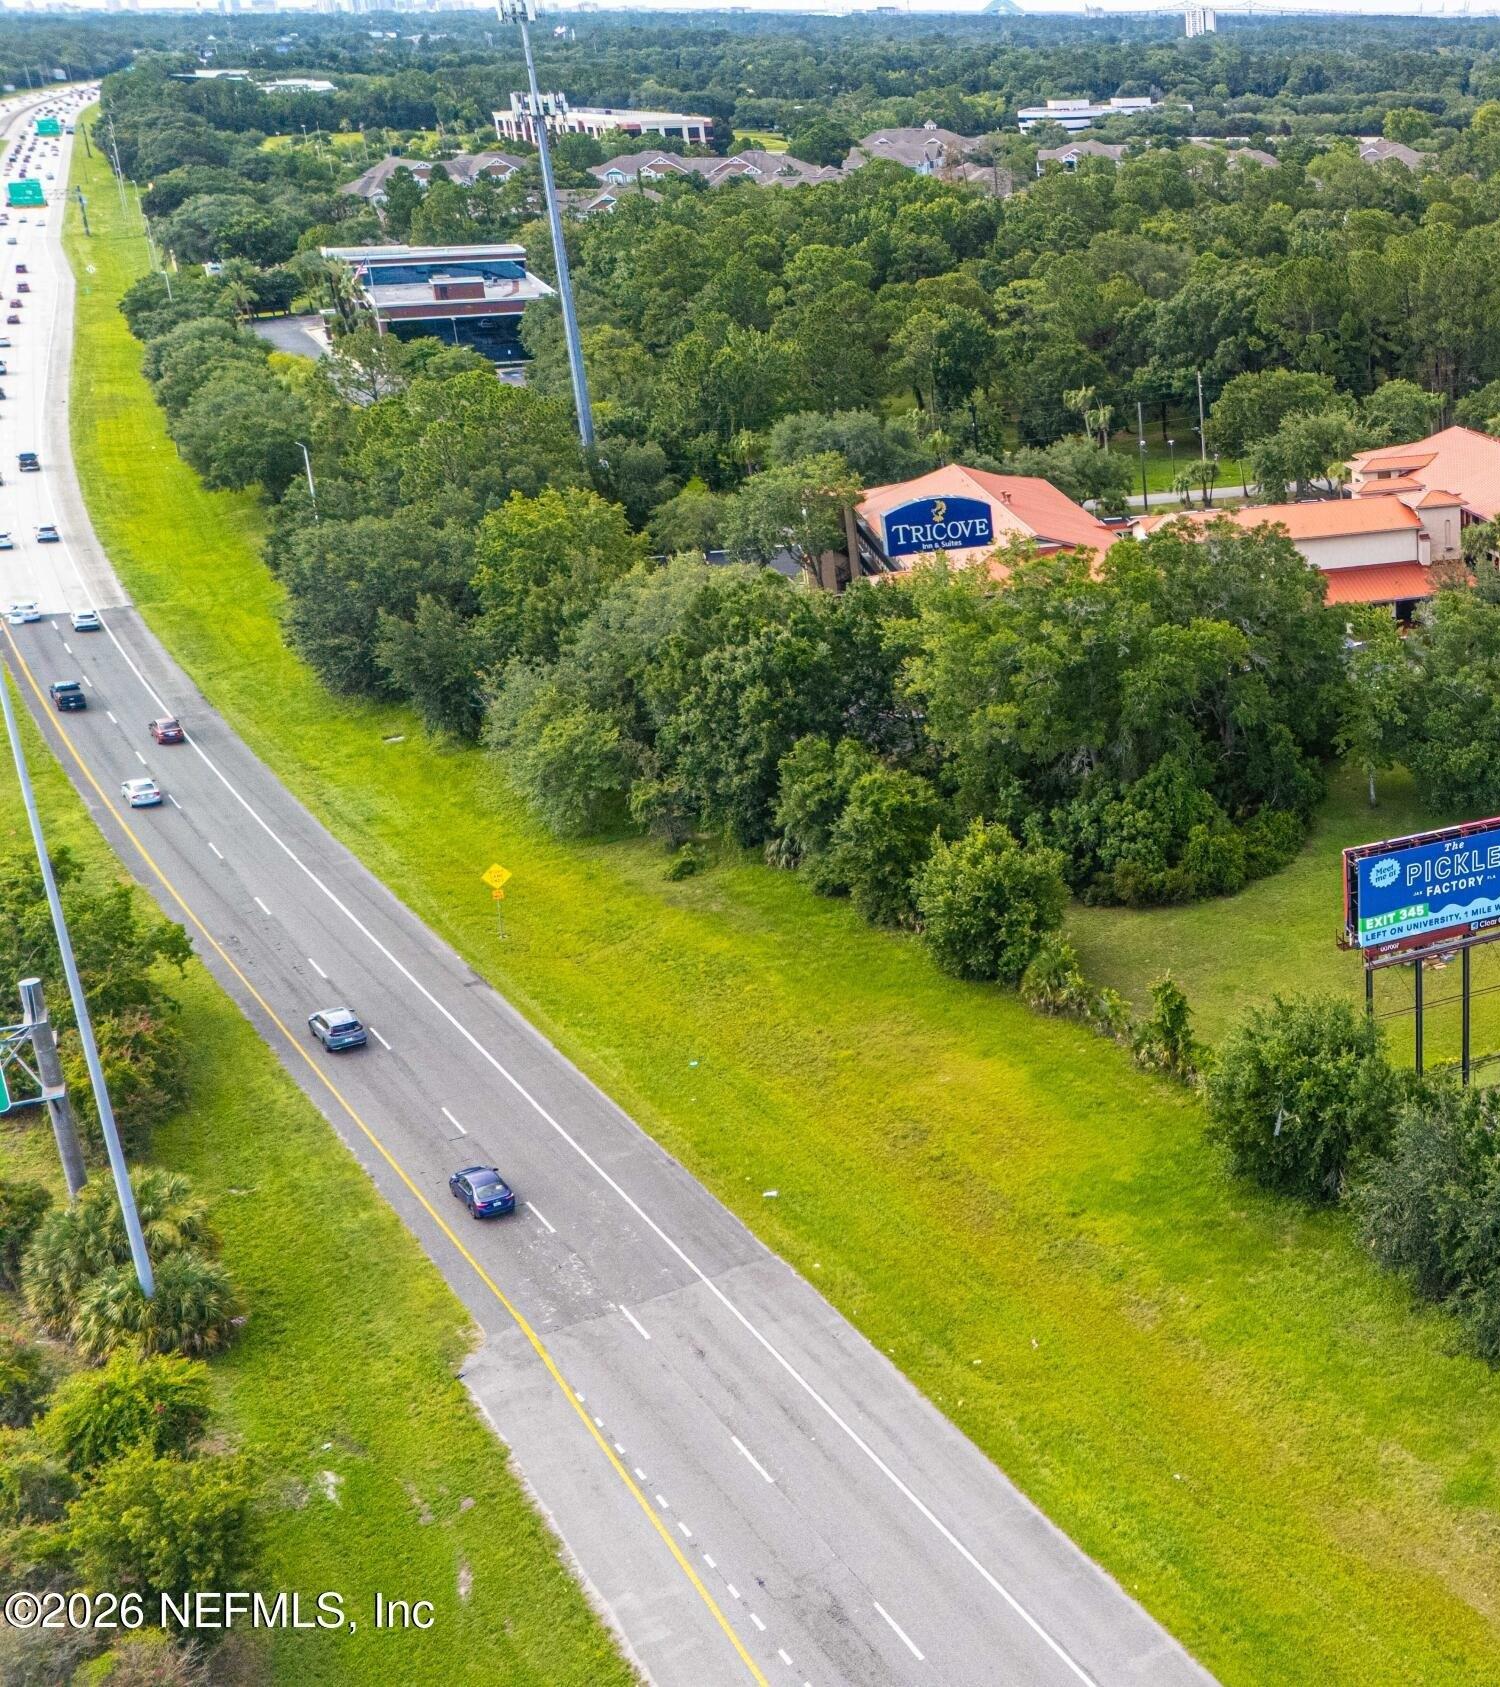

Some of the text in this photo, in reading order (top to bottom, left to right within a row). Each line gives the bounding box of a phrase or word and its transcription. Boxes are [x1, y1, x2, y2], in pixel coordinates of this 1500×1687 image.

[891, 518, 989, 545] TRICOVE
[941, 540, 962, 548] Suites
[1444, 841, 1465, 852] The
[1406, 845, 1500, 886] PICKLE
[1426, 875, 1484, 897] FACTORY
[1365, 930, 1387, 942] LEFT
[1390, 925, 1404, 936] ON
[1406, 912, 1462, 932] UNIVERSITY,
[1471, 905, 1492, 917] MILE
[1366, 904, 1424, 930] EXIT 345
[1479, 918, 1497, 928] Clear
